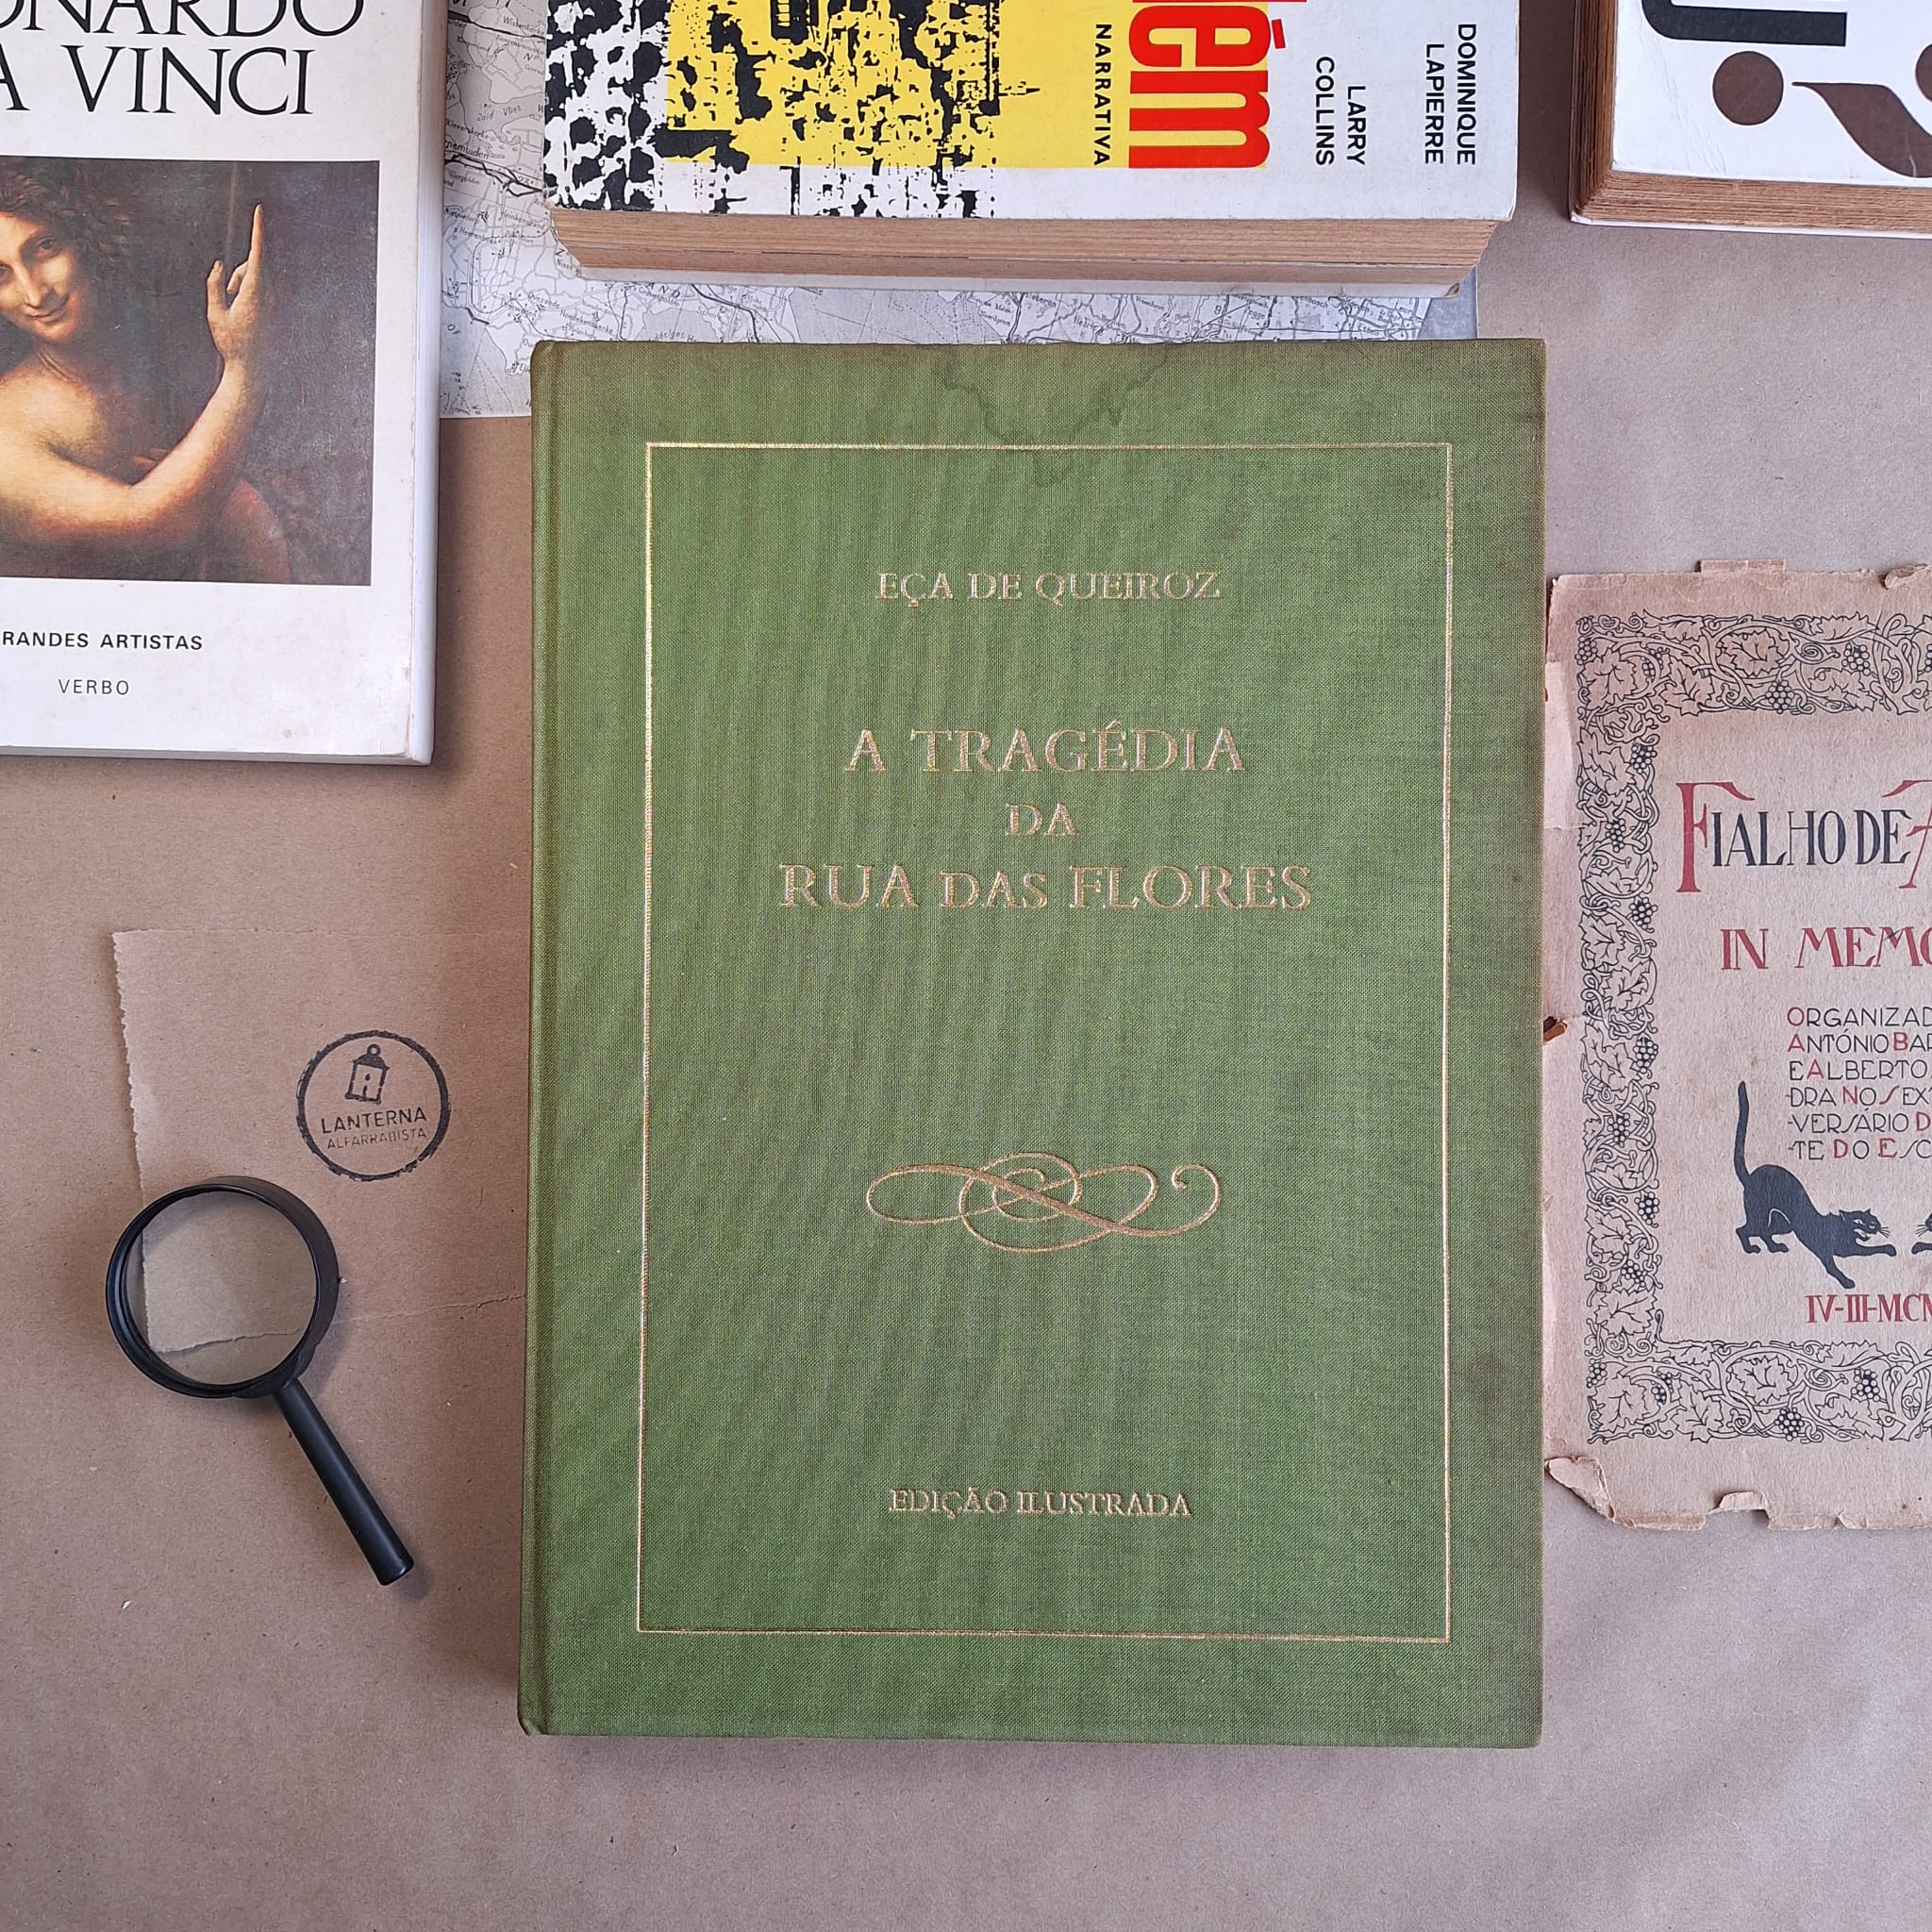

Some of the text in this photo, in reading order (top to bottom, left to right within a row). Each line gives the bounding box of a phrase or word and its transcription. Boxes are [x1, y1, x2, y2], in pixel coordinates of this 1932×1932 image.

[60, 44, 315, 115] VINCI
[1093, 23, 1113, 166] NARRATIVA
[1457, 24, 1477, 165] DOMINIQUE
[1315, 56, 1336, 166] COLLINS
[1424, 43, 1445, 164] LAPIERRE
[1346, 85, 1367, 166] LARRY
[877, 572, 1222, 608] EÇA DE QUEIROZ
[2, 631, 203, 651] RANDES ARTISTAS
[58, 678, 130, 696] VERBO
[843, 719, 1245, 773] A TRAGÉDIA
[1006, 802, 1079, 838] DA
[1674, 781, 1847, 893] FIALHO
[1852, 808, 1912, 866] DE
[779, 863, 1312, 911] RUA DAS FLORES
[1720, 927, 1769, 971] IN
[1787, 1027, 1890, 1054] ANTÓNIO
[1789, 1058, 1928, 1081] E ALBERTO
[1879, 1085, 1932, 1107] SEX
[321, 1107, 427, 1134] LANTERNA
[327, 1127, 427, 1150] ALFARRABISTA
[1833, 1138, 1870, 1160] DO
[889, 1486, 1193, 1519] EDIÇÃO ILUSTRADA
